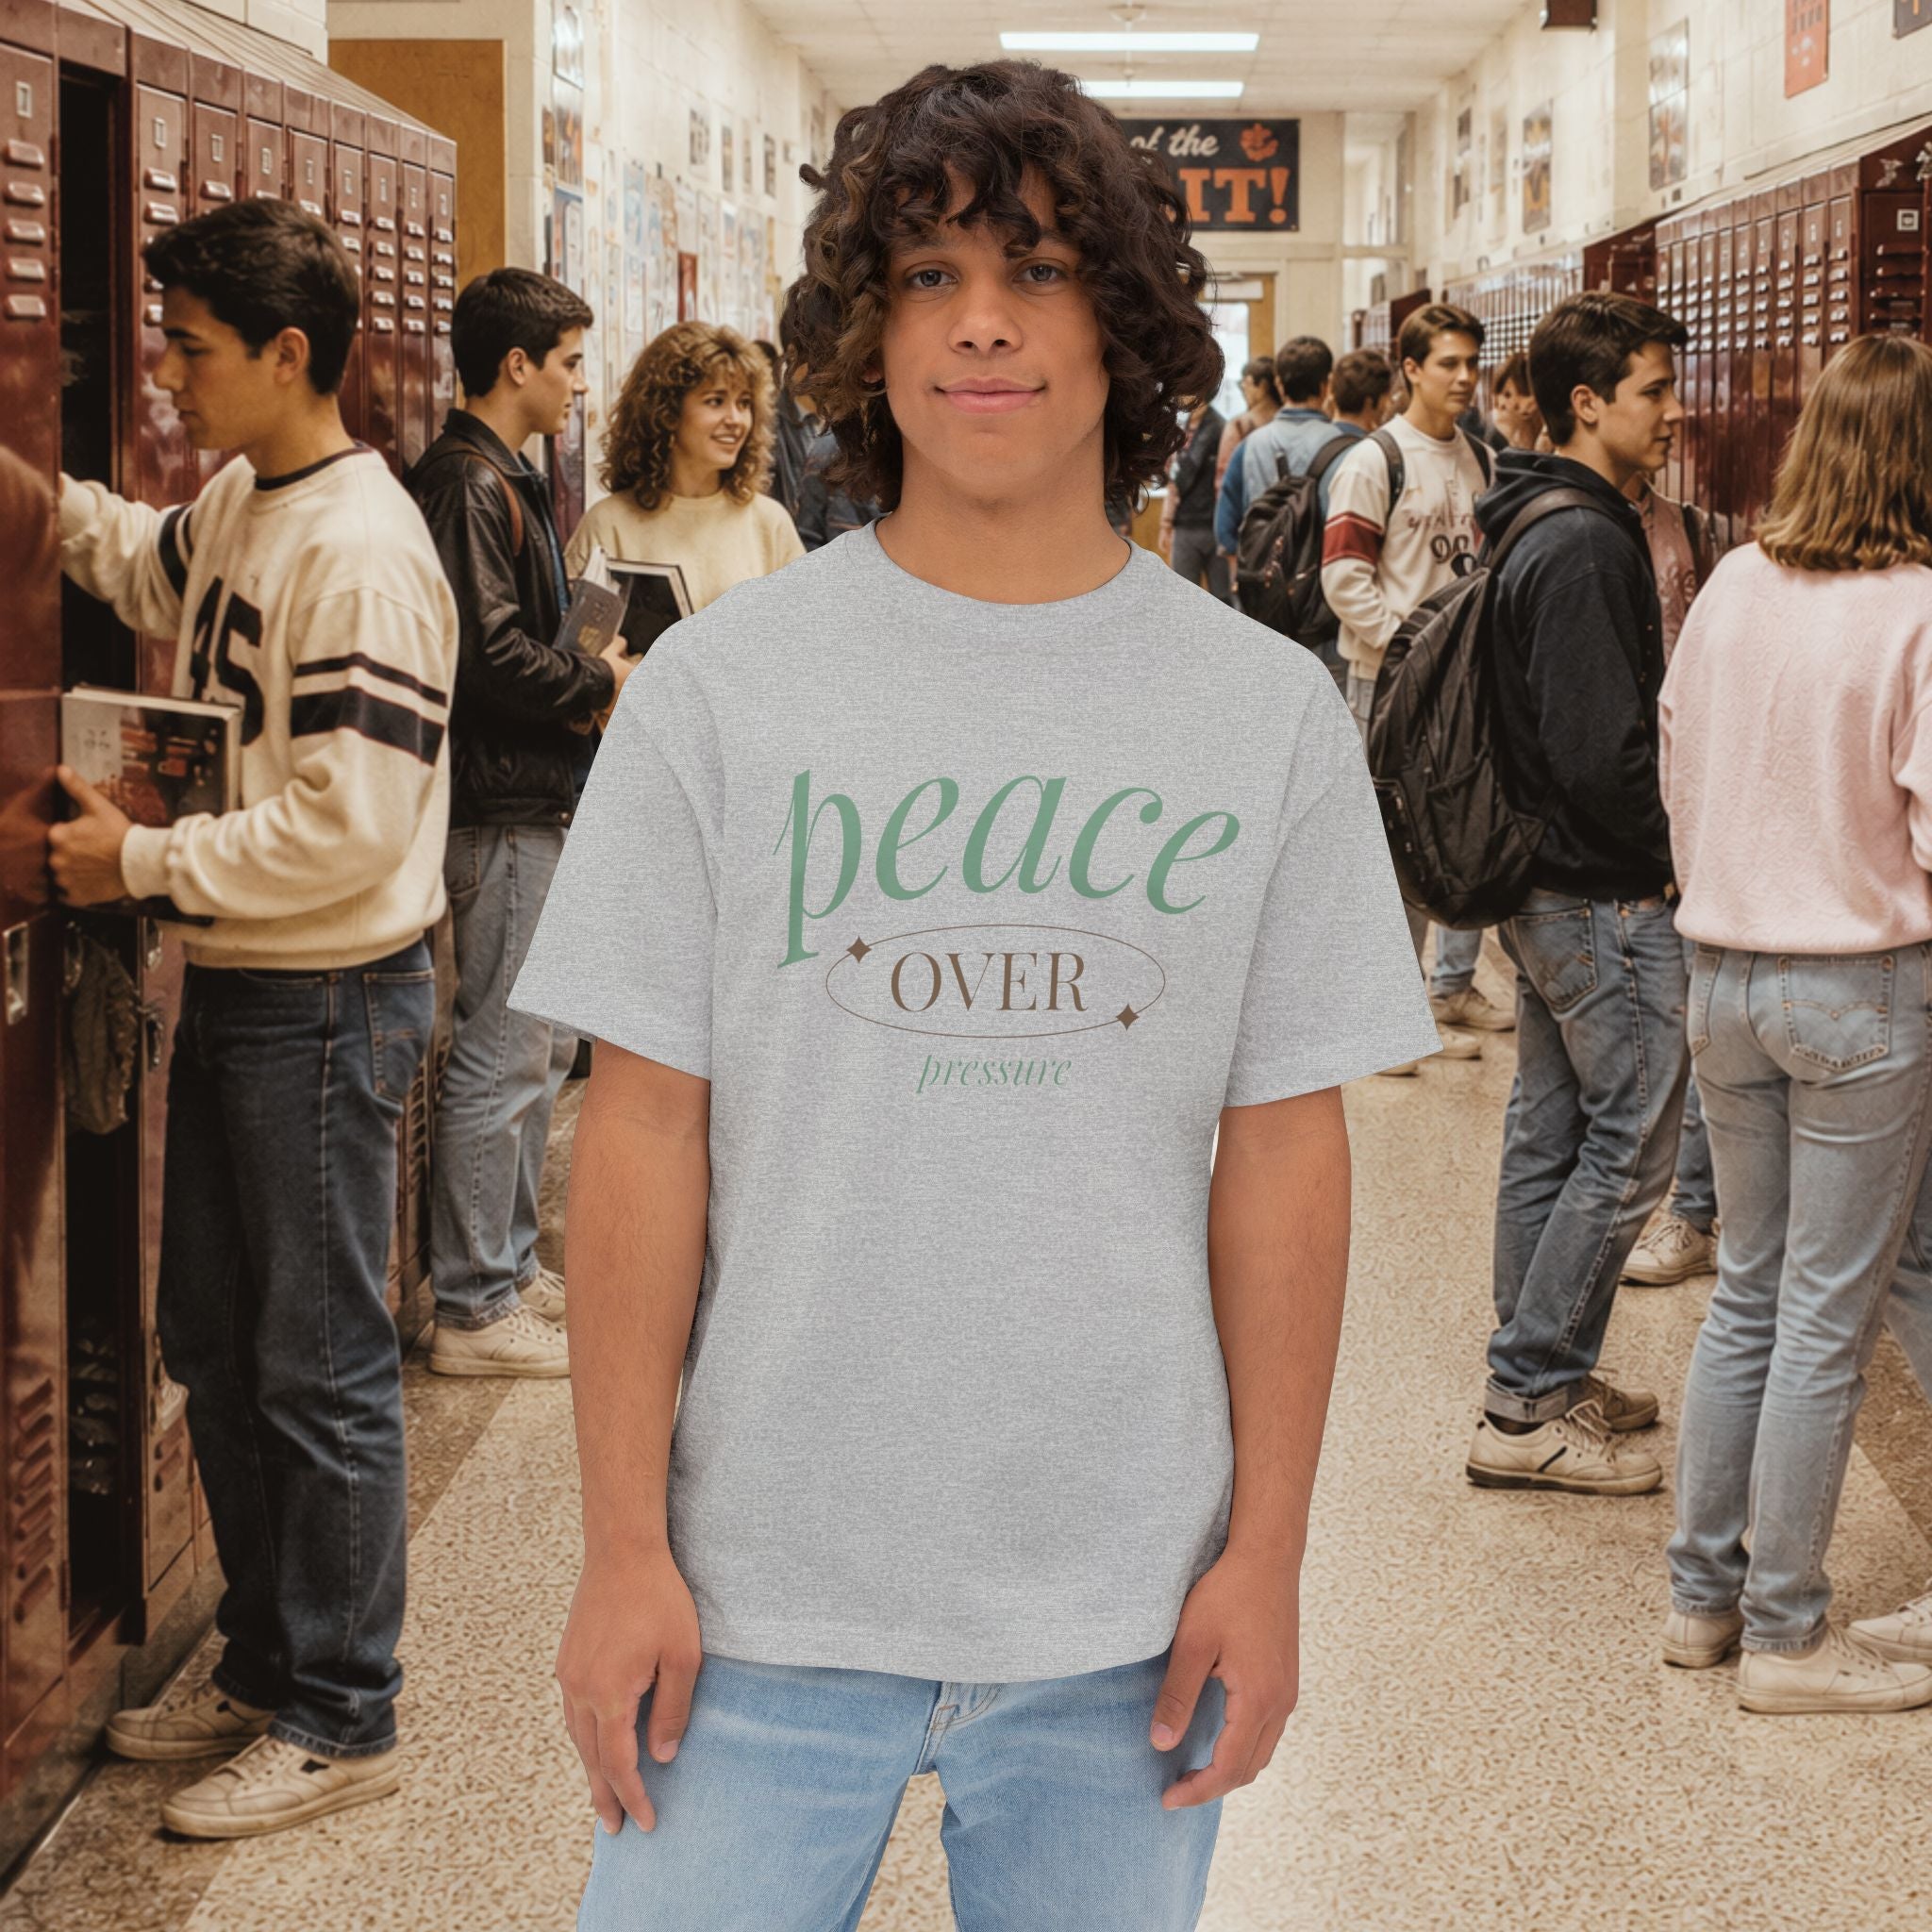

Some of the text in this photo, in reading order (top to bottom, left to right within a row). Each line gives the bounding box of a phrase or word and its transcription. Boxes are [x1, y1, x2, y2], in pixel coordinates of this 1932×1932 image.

[1167, 124, 1220, 157] the
[773, 769, 1241, 969] peace
[891, 951, 1089, 1012] OVER
[915, 1055, 1073, 1094] pressure
